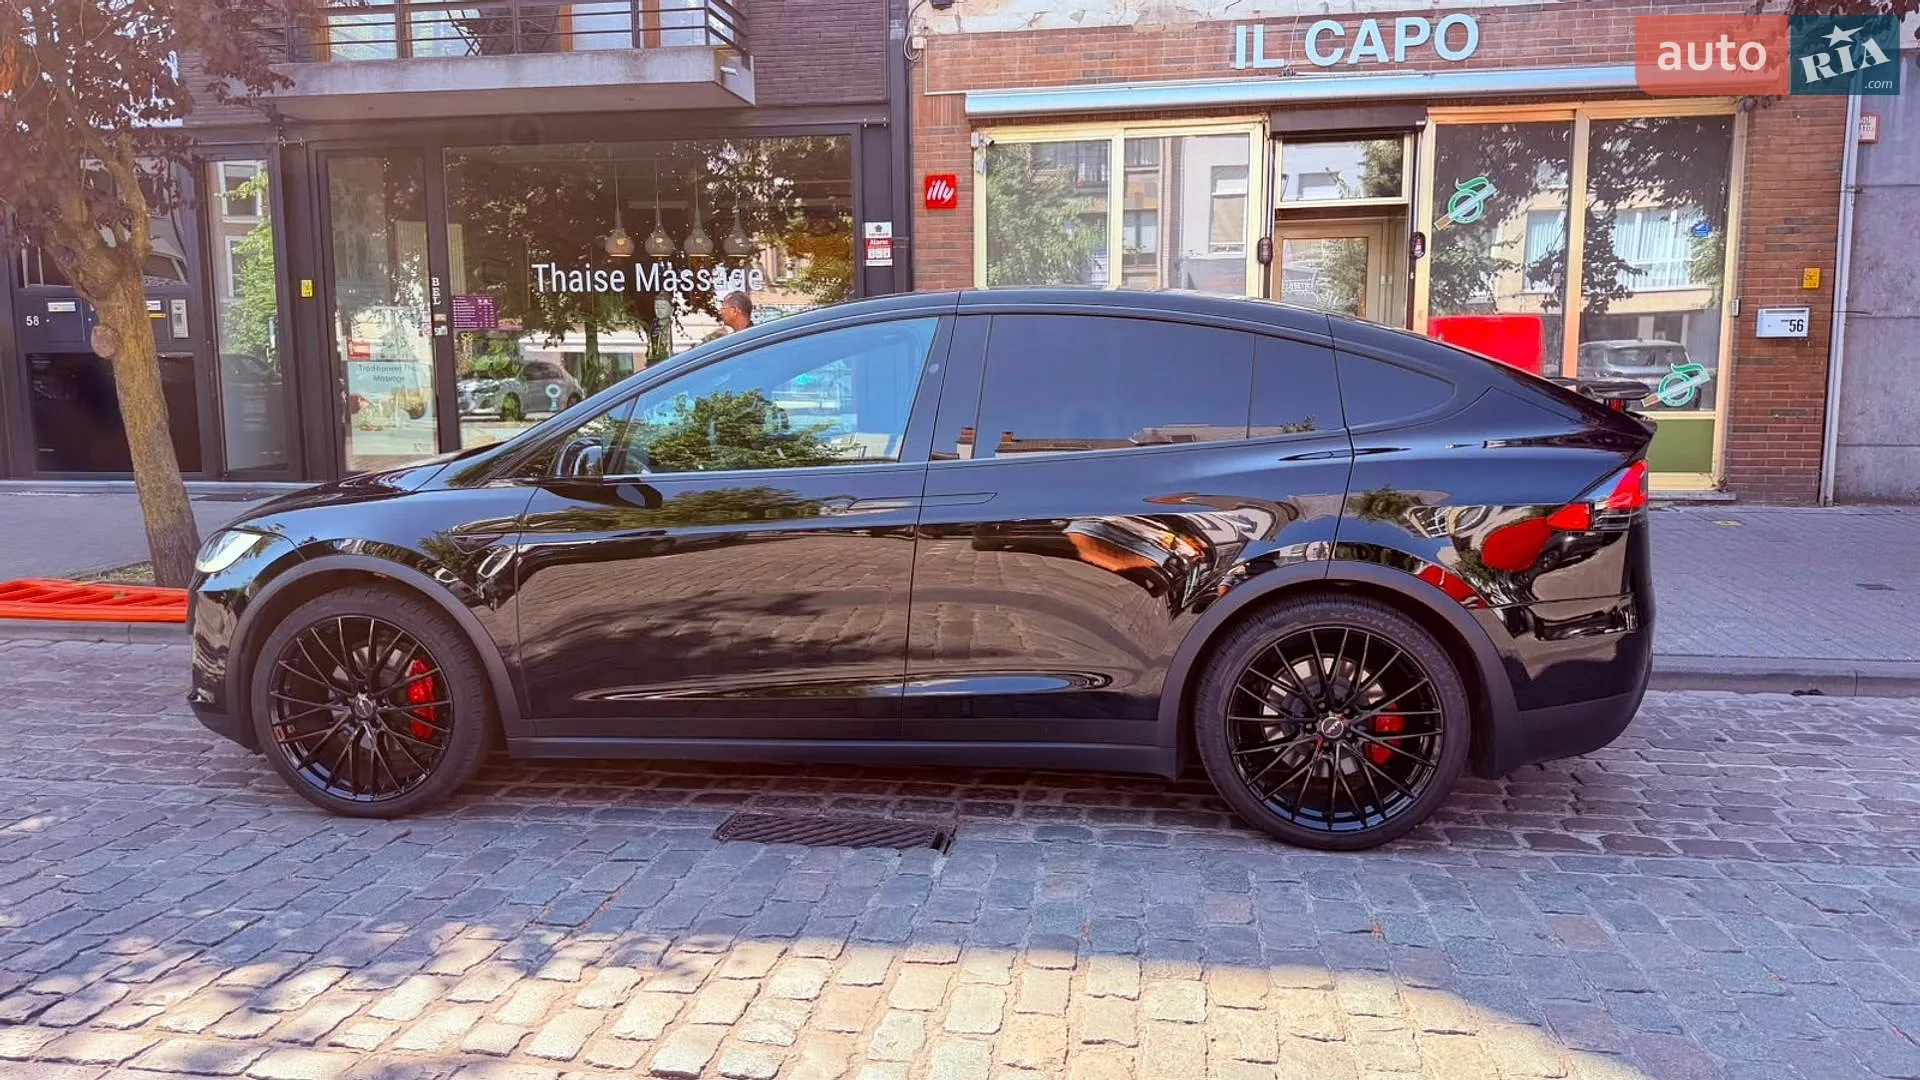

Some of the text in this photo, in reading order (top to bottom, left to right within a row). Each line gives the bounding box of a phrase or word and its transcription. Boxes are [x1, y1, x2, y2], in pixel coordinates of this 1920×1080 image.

[1235, 13, 1480, 70] IL CAPO
[926, 179, 955, 204] illy
[531, 262, 764, 296] Thaise Massage
[26, 315, 40, 327] 58
[1788, 318, 1805, 333] 56
